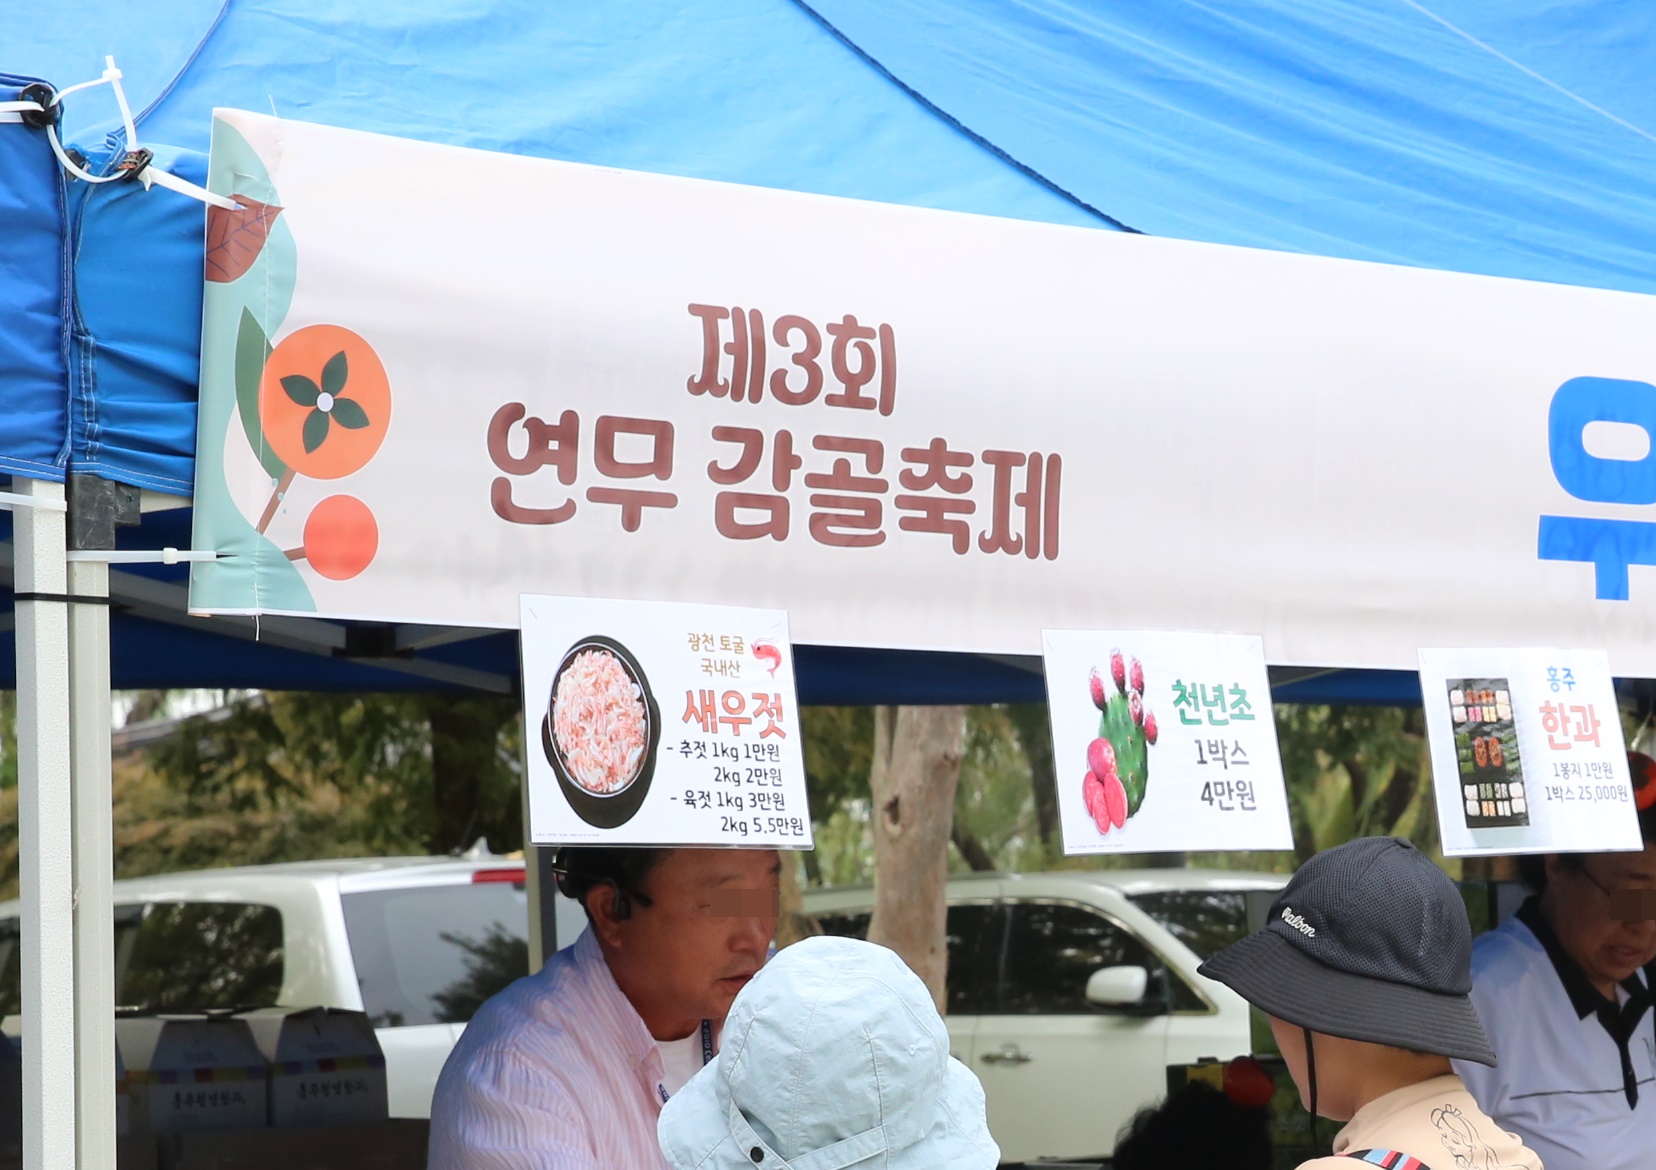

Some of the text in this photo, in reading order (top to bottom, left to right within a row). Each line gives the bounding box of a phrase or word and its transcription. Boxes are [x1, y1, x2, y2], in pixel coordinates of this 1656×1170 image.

[687, 303, 897, 416] 제3회
[487, 402, 1062, 561] 연무 감골축제
[687, 633, 745, 655] 광천 토굴
[700, 658, 741, 678] 국내산
[1546, 665, 1576, 693] 홍주
[682, 689, 787, 739] 새우젓
[1171, 679, 1255, 726] 천년초
[1538, 700, 1601, 751] 한과
[679, 740, 781, 762] 추젓 1kg 1만원
[1194, 739, 1249, 769] 1박스
[713, 767, 783, 787] 2kg 2만원
[1553, 762, 1614, 781] 1봉지 1만원
[683, 790, 786, 812] 육젓 1kg 3만원
[1200, 779, 1257, 811] 4만원
[1545, 785, 1629, 803] 1박스 25,000원
[720, 816, 804, 836] 2kg 5.5만원
